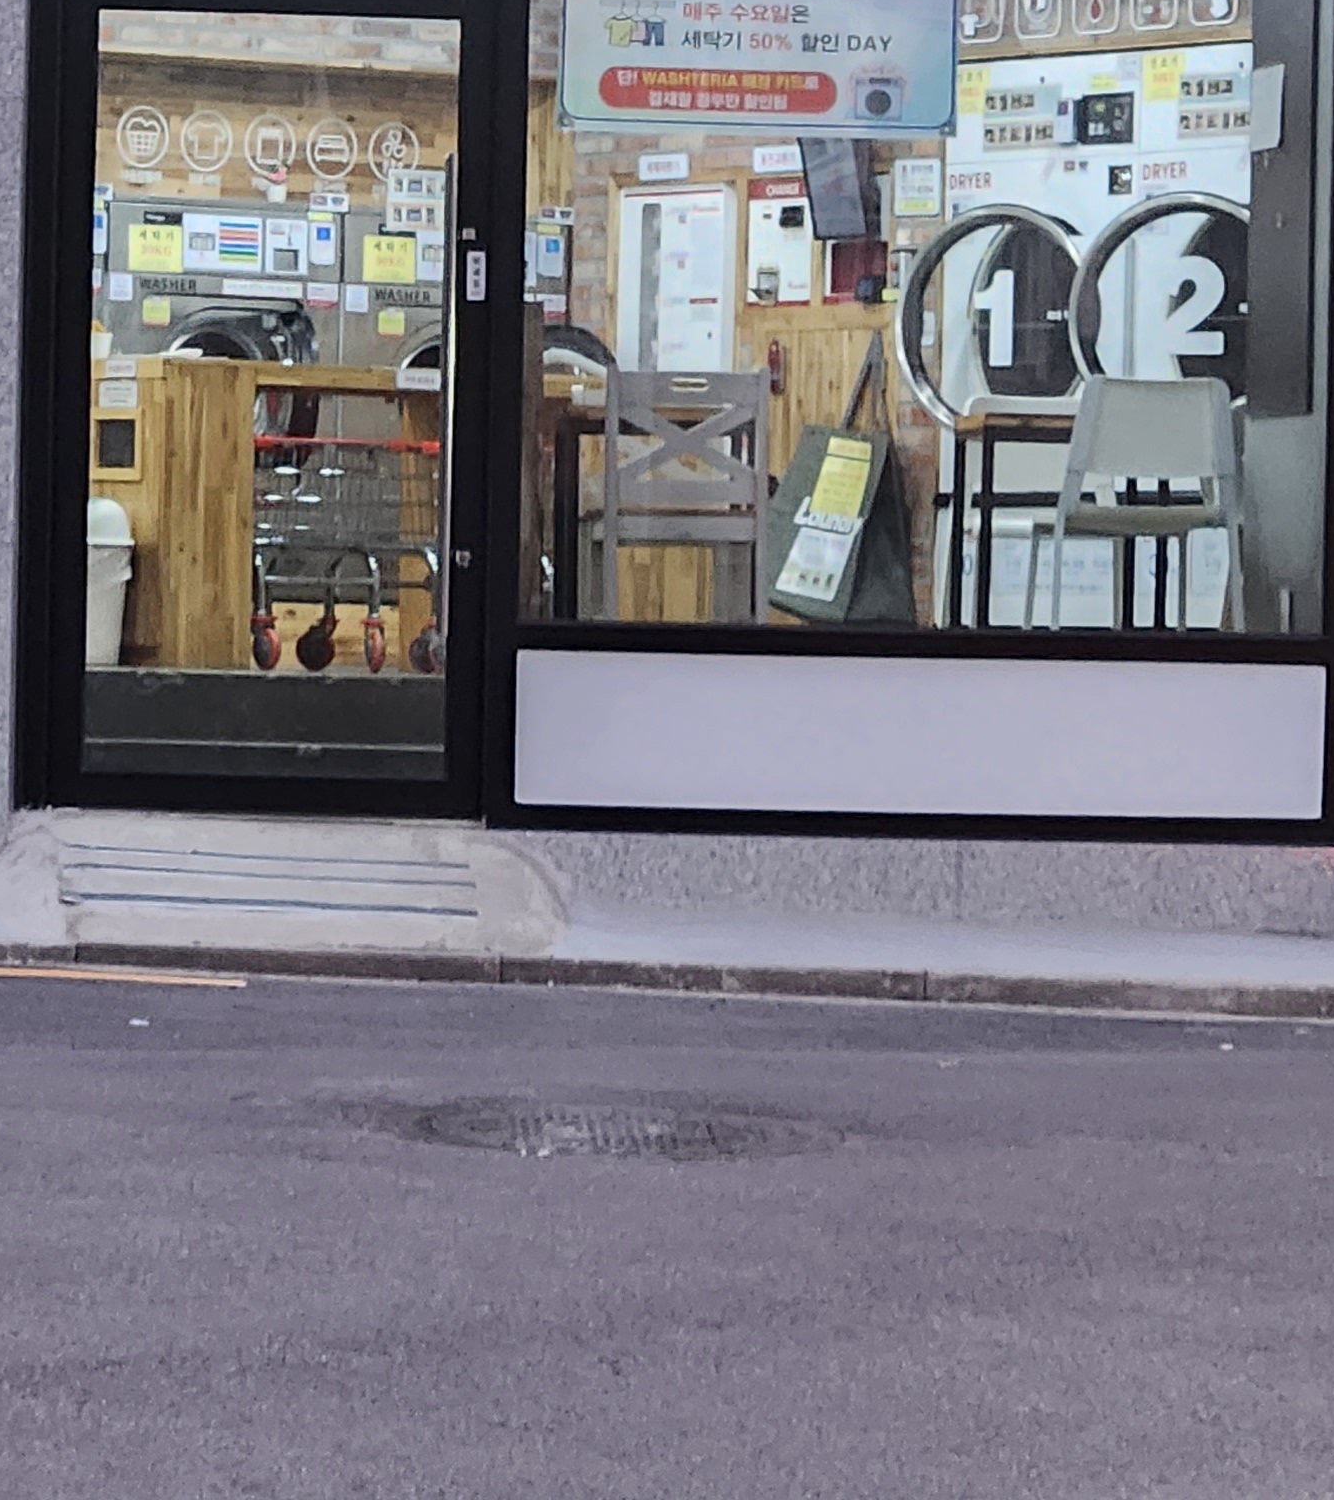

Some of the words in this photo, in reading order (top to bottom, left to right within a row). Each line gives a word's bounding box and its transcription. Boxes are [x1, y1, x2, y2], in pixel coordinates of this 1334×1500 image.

[682, 2, 723, 22] 매주
[729, 2, 811, 25] 수요일은
[680, 30, 743, 51] 세탁기
[748, 31, 793, 52] 50%
[800, 32, 839, 54] 할인
[846, 33, 894, 54] DAY
[948, 172, 992, 190] DRYER
[1141, 161, 1188, 181] DRYER
[138, 276, 198, 293] WASHER
[374, 288, 432, 304] WASHER
[1167, 254, 1226, 357] 2
[973, 269, 1014, 368] 1
